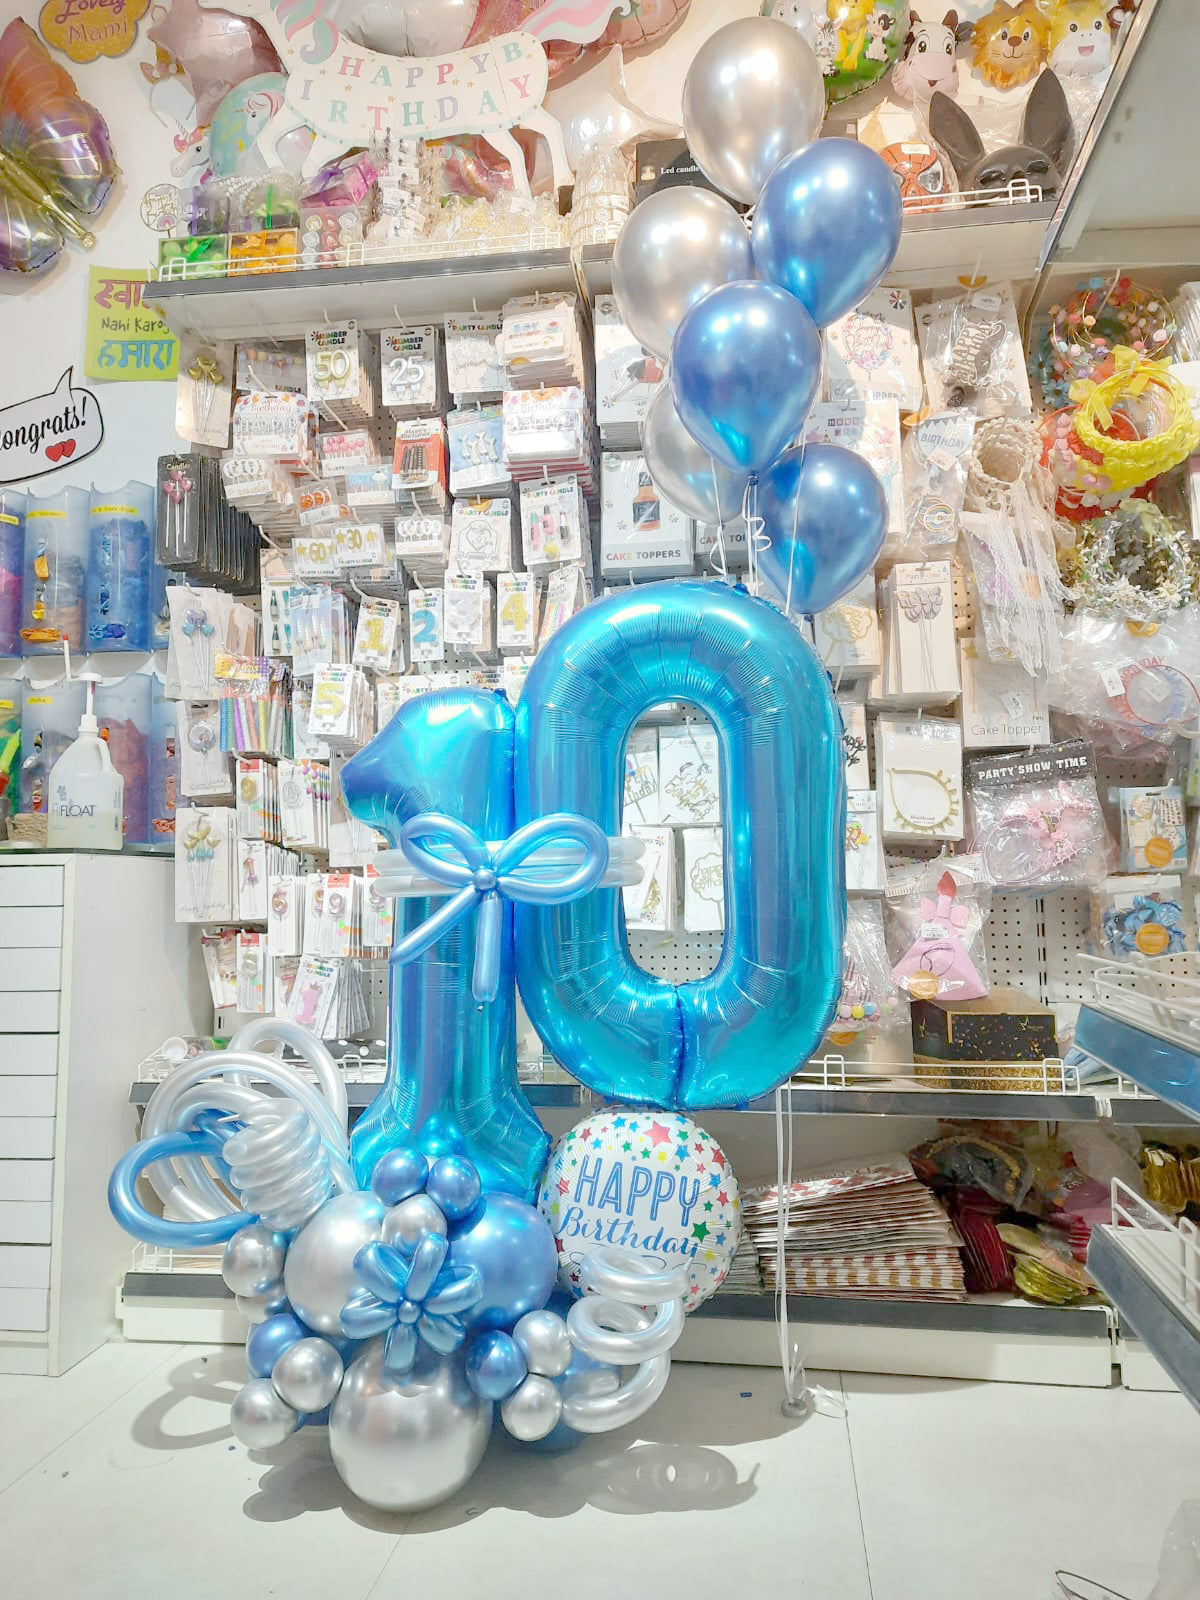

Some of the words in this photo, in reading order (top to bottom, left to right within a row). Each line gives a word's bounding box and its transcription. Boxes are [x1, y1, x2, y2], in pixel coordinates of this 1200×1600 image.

[67, 16, 128, 45] Mami
[337, 52, 490, 88] HAPPY
[101, 317, 130, 332] Nahi
[315, 331, 348, 340] NUMBER
[97, 339, 177, 371] हमारा
[390, 336, 423, 345] NUMBER
[314, 349, 350, 380] 50
[389, 355, 424, 386] 25
[0, 396, 88, 456] ongrats!
[920, 432, 968, 450] BIRTHDAY
[346, 529, 363, 550] 30
[606, 551, 632, 561] CAKE
[636, 549, 681, 560] TOPPERS
[412, 609, 437, 644] 2
[501, 593, 529, 632] 4
[360, 617, 387, 652] 1
[315, 682, 344, 717] 5
[971, 723, 999, 737] Cake
[1001, 722, 1043, 738] Topper
[978, 766, 1014, 781] PARTY
[1018, 761, 1051, 775] SHOW
[1056, 756, 1088, 770] TIME
[573, 1154, 701, 1228] HAPPY
[554, 1205, 699, 1259] Birthday
